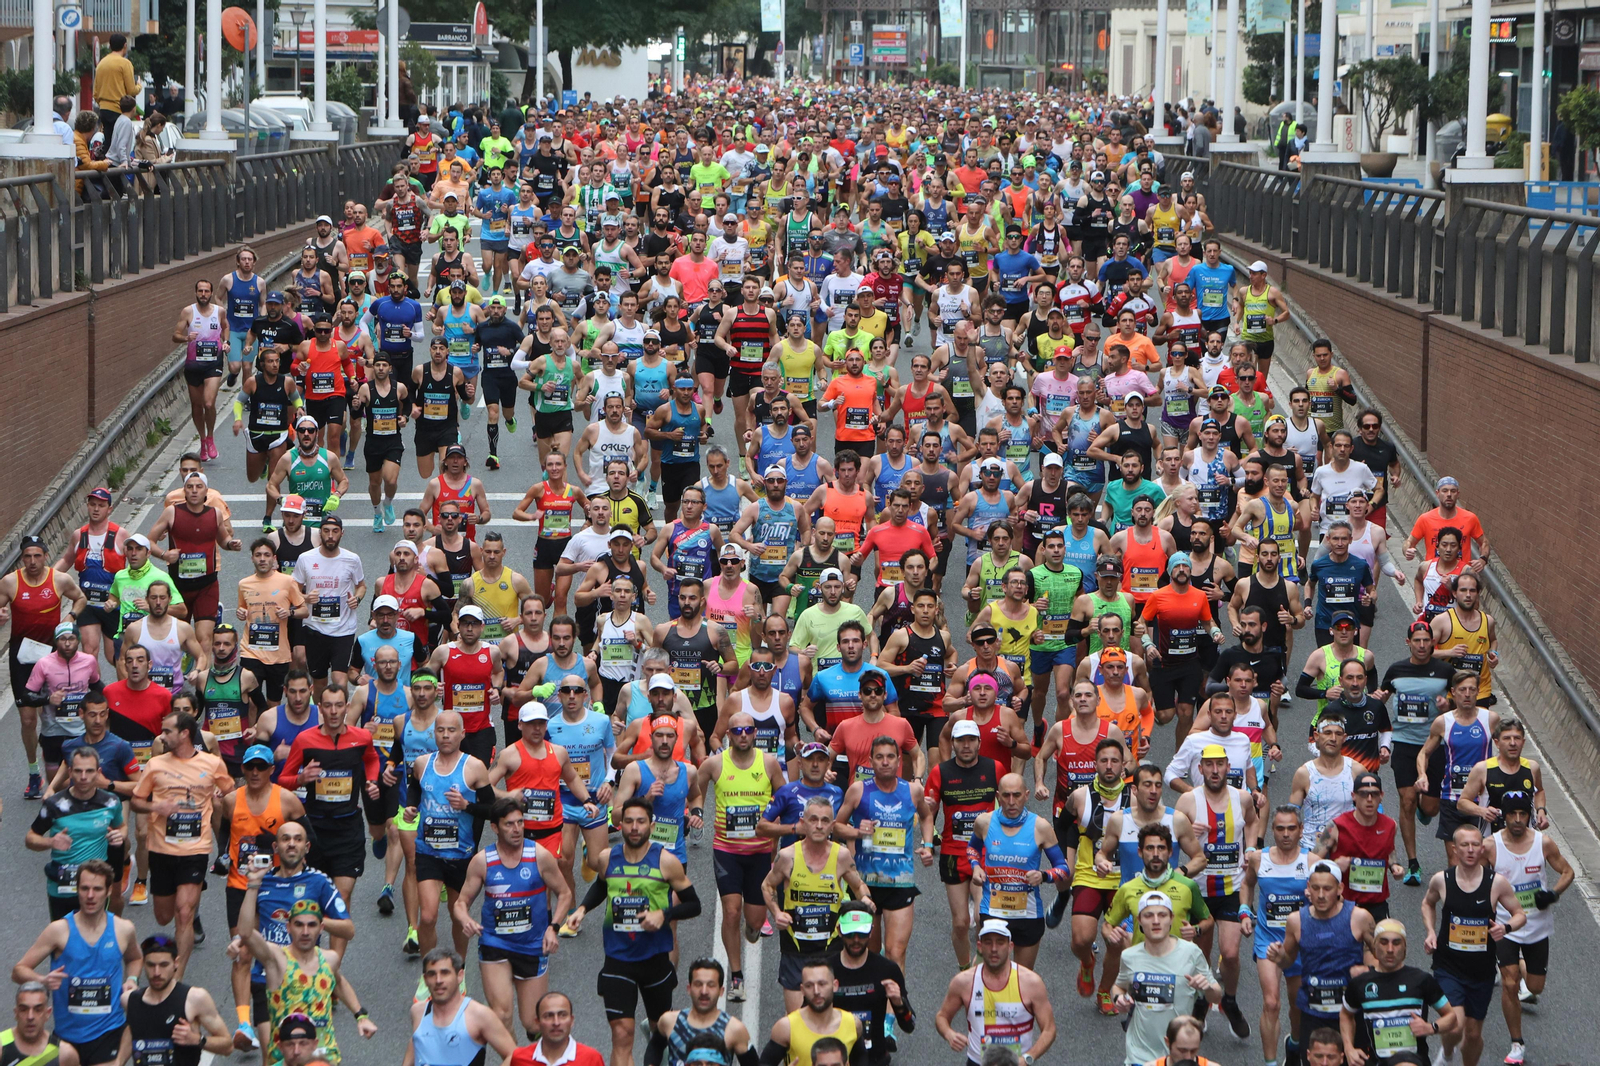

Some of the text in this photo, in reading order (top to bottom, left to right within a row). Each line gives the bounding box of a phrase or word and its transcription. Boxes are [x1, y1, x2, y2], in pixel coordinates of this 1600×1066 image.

[261, 328, 277, 337] PERÚ
[296, 481, 324, 491] ETHIOPIA
[988, 853, 1028, 863] enerplus
[994, 867, 1025, 877] Maratón
[1517, 882, 1538, 891] ZURICH
[504, 900, 527, 908] ZURICH
[82, 976, 108, 986] ZURICH
[1147, 974, 1171, 982] ZURICH
[147, 1040, 170, 1050] ZURICH
